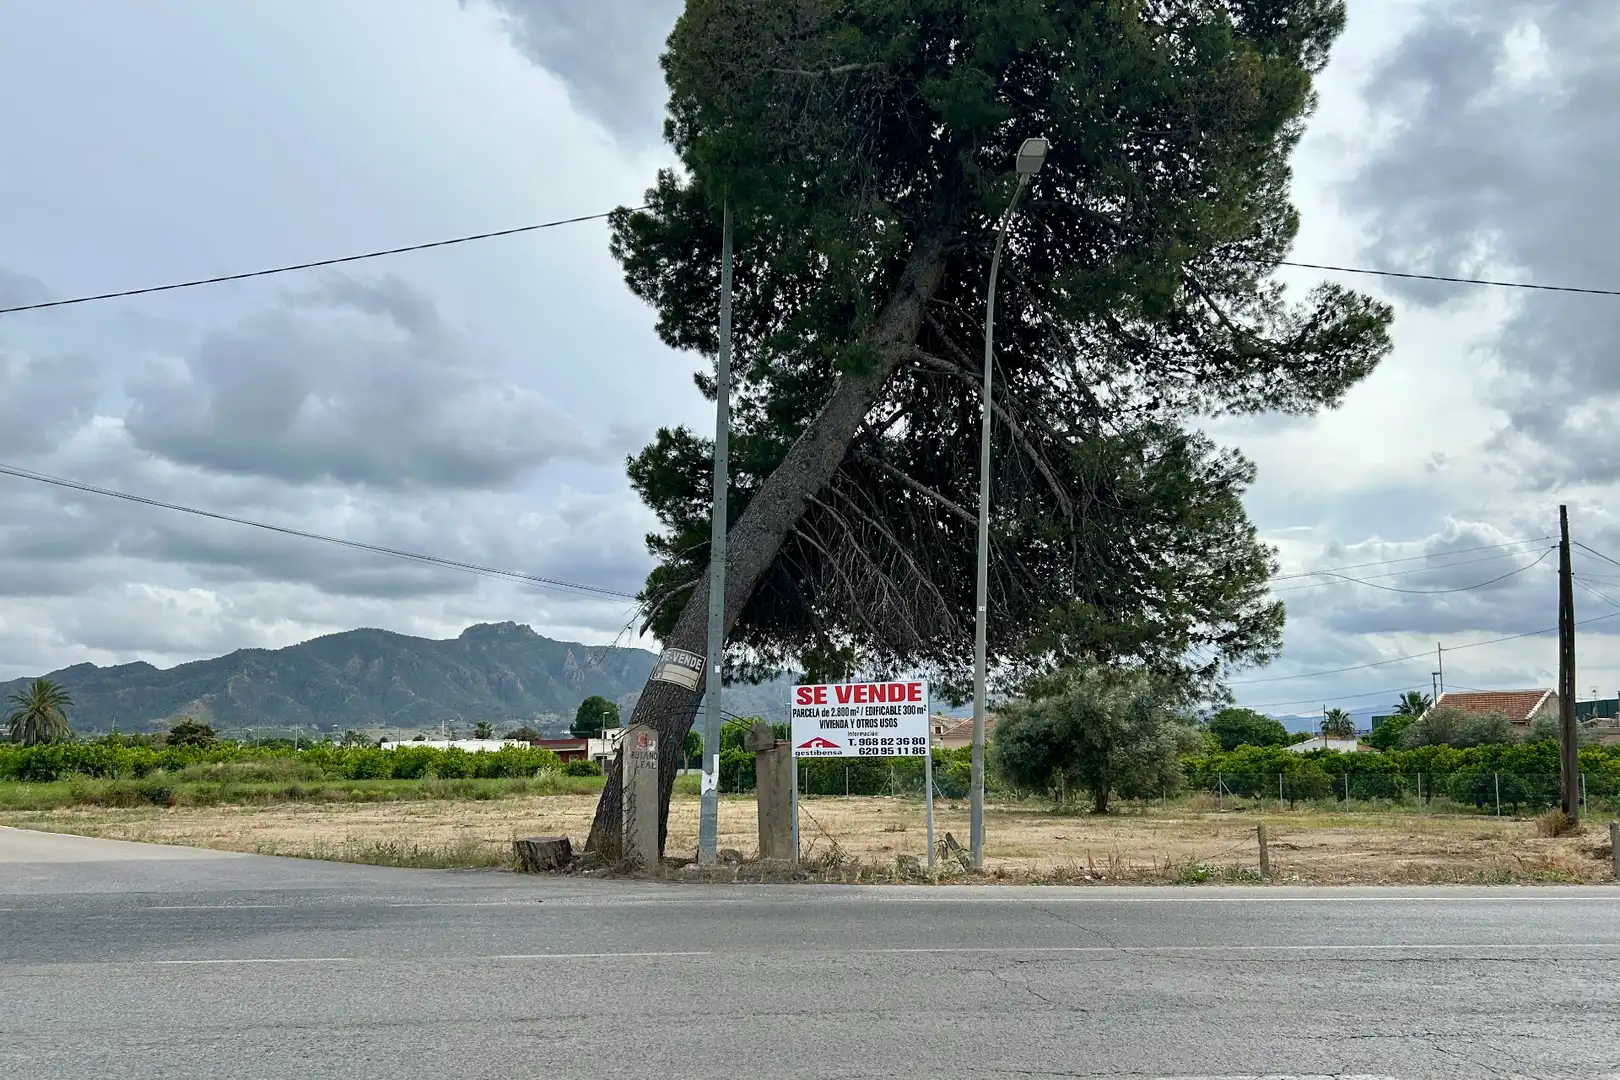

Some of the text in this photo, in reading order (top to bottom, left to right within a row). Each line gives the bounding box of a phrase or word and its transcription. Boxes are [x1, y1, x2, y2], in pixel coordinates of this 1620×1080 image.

[796, 682, 922, 705] SE VENDE
[792, 708, 820, 718] PARCELA
[821, 708, 830, 717] de
[831, 707, 850, 717] 2.800
[865, 705, 902, 716] EDIFICABLE
[902, 705, 916, 715] 300
[819, 718, 898, 729] VIVIENDA Y OTROS USOS
[847, 737, 926, 747] T. 968 82 36 80
[858, 747, 926, 755] 620 95 11 86
